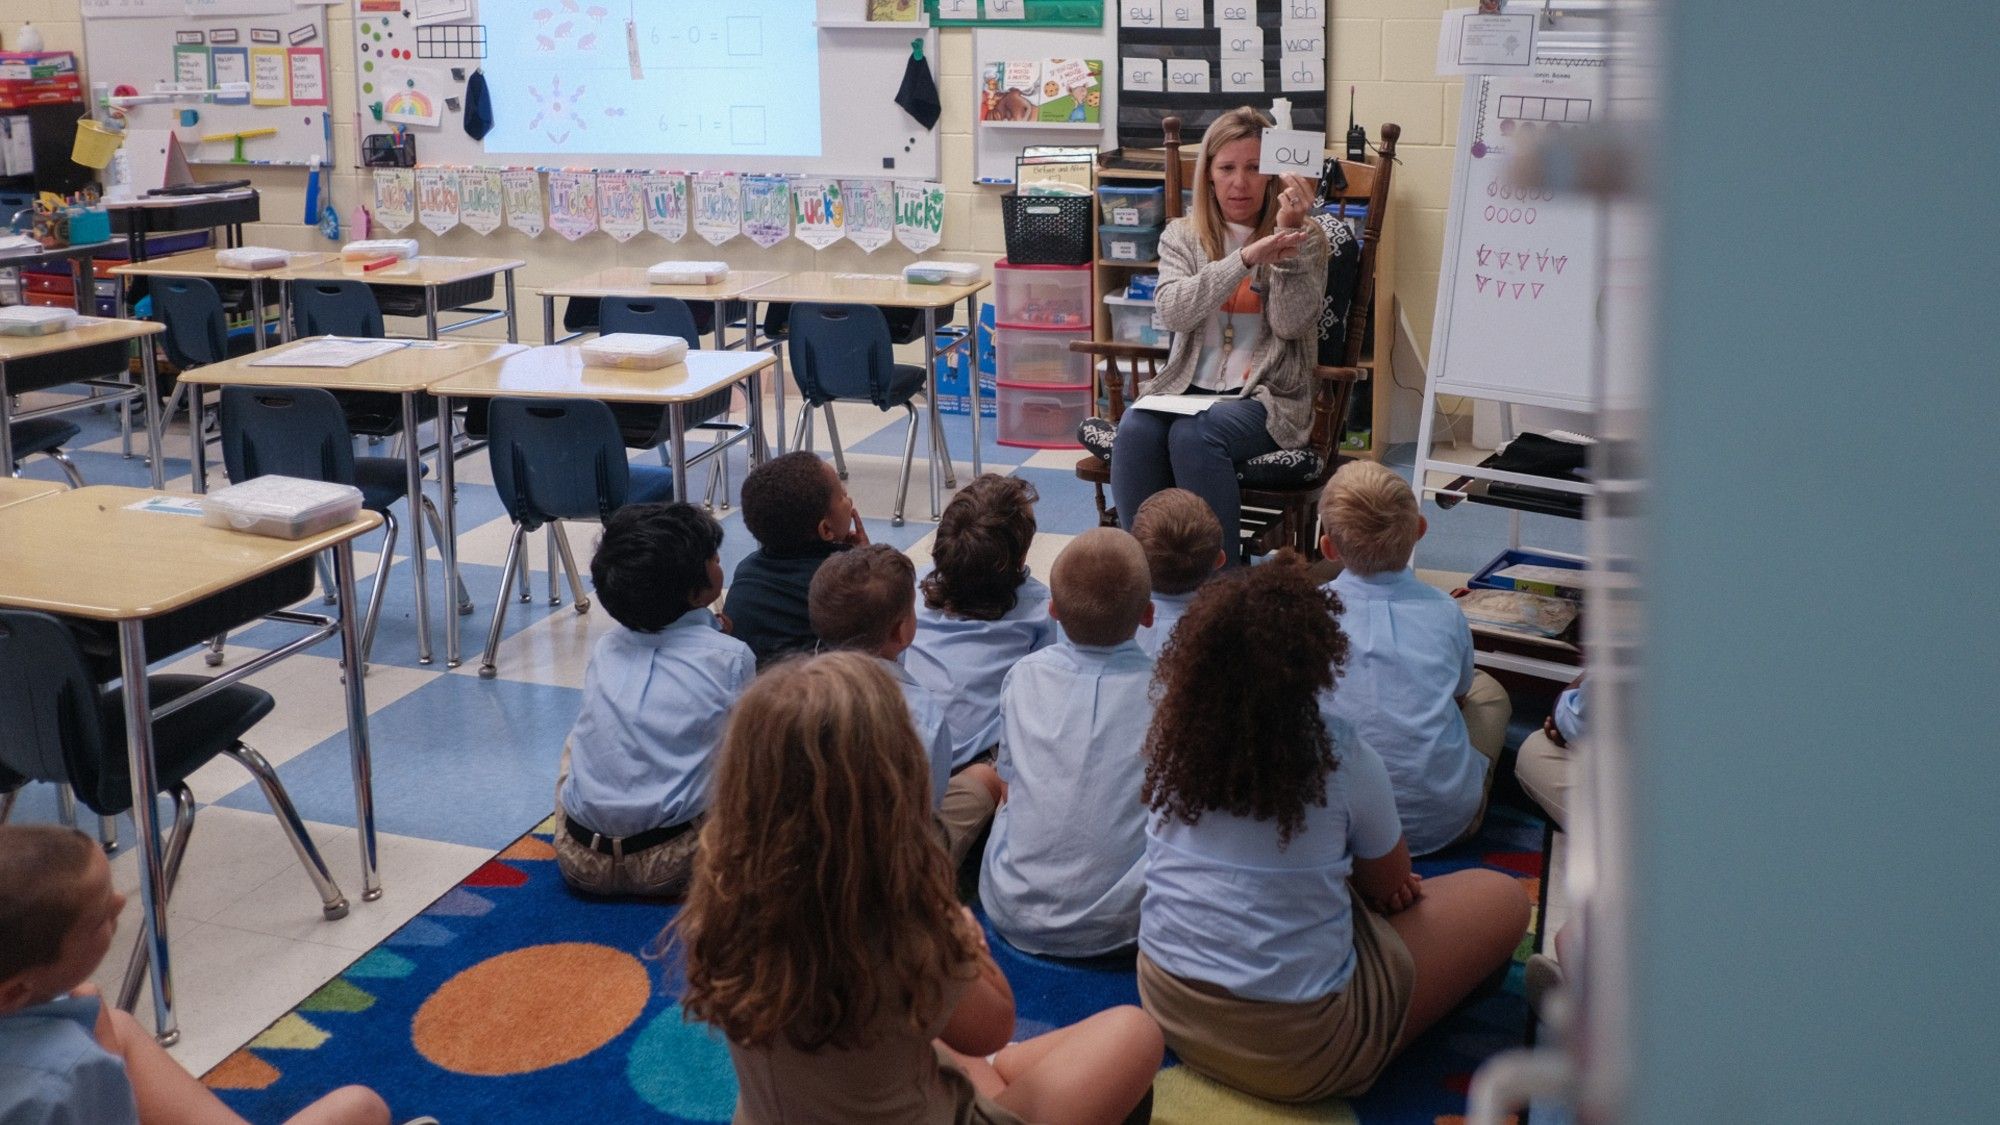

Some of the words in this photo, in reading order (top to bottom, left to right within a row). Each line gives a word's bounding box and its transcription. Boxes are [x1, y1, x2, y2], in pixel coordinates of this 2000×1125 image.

[1130, 8, 1152, 24] ey
[1175, 8, 1189, 19] ei
[1225, 8, 1246, 18] ee
[1290, 0, 1316, 19] tch
[651, 26, 660, 45] 6
[688, 26, 701, 44] 0
[1133, 71, 1153, 82] er
[1292, 60, 1313, 83] ch
[658, 114, 668, 132] 6
[1276, 147, 1310, 166] ou
[419, 179, 458, 215] Lucky
[549, 184, 596, 219] Lucky
[600, 186, 641, 221] Lucky
[794, 191, 843, 229] Lucky
[843, 193, 892, 230] Lucky
[895, 191, 944, 233] Lucky
